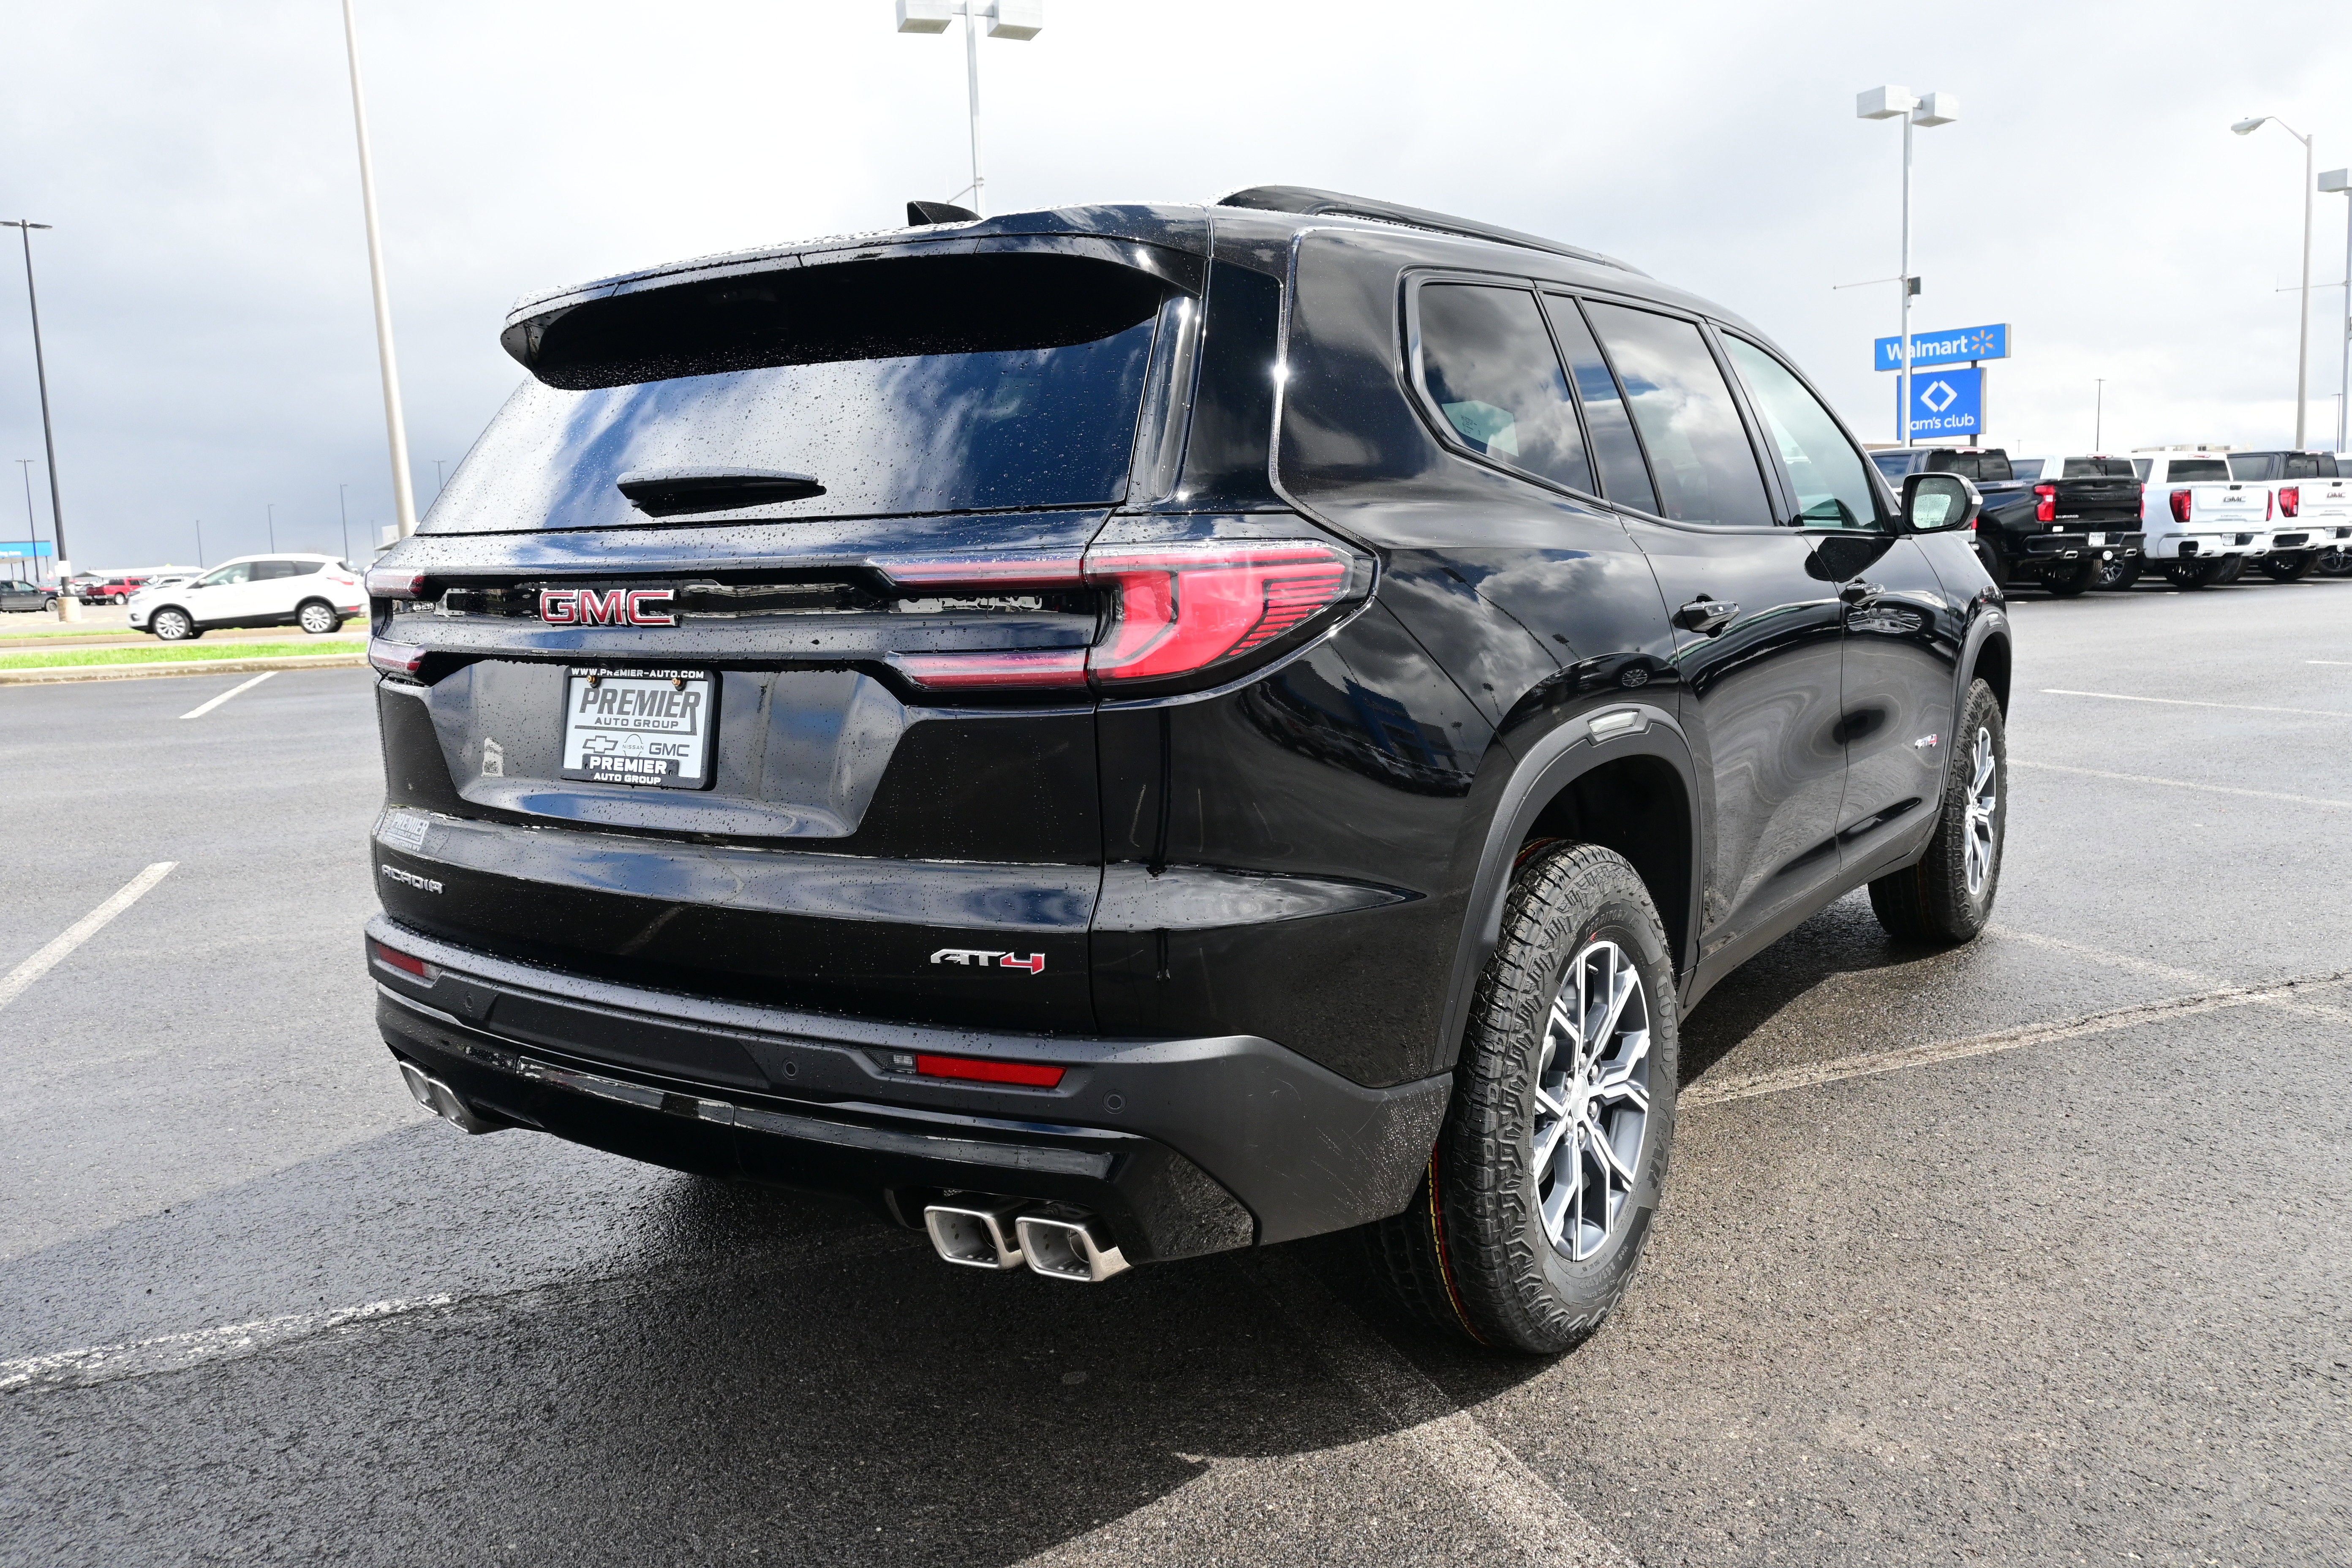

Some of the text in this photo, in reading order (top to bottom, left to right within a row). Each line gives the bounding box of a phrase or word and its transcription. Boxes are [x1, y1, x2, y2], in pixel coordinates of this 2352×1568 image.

[1910, 413, 1974, 430] am's club
[540, 588, 677, 626] GMC
[572, 668, 704, 678] WWW.PREMIER-AUTO.COM
[579, 688, 701, 718] PREMIER
[595, 717, 678, 729] AUTO GROUP
[649, 742, 690, 757] GMC
[589, 756, 667, 775] PREMIER
[593, 772, 662, 784] AUTO GROUP
[391, 812, 429, 836] PREMIER
[381, 864, 444, 894] ACADIA
[931, 948, 1045, 975] AT4
